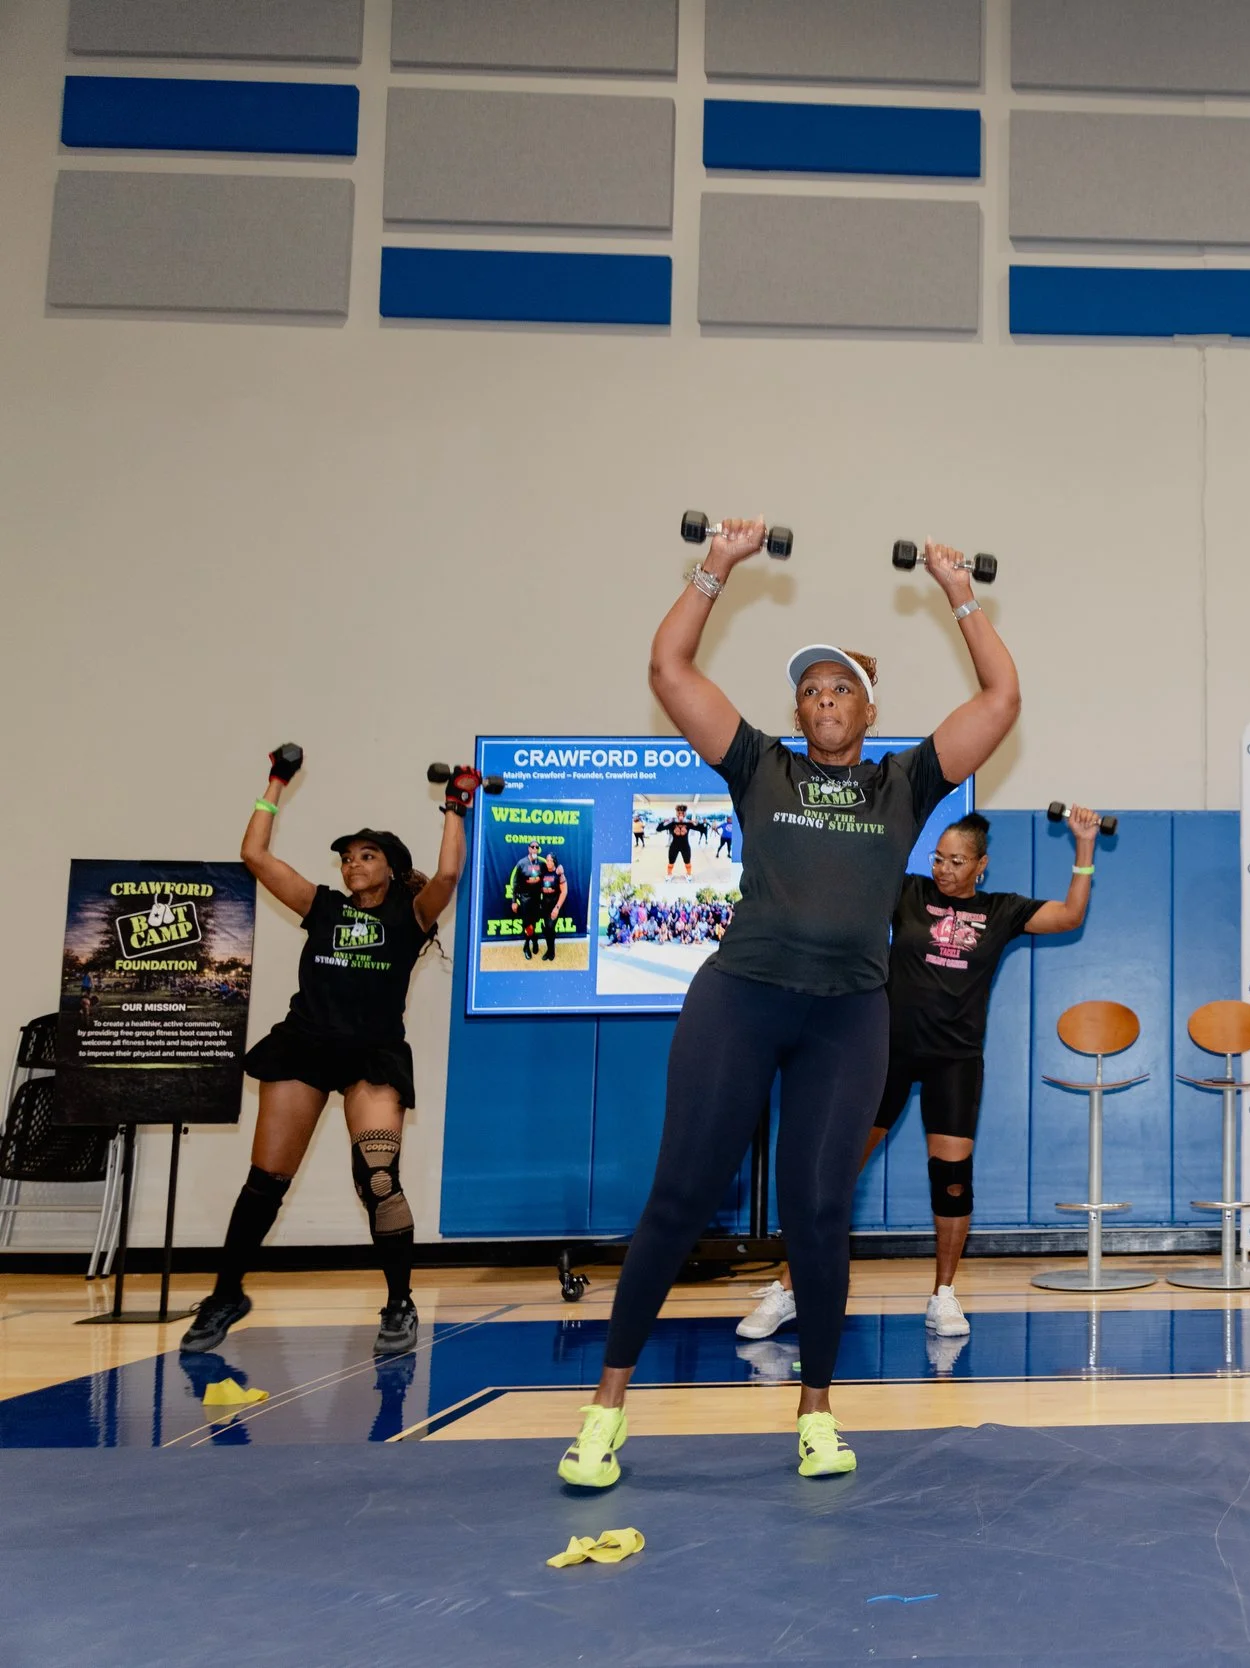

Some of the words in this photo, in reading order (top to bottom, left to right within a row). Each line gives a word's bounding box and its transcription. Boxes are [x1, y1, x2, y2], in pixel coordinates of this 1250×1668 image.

[514, 750, 638, 767] CRAWFORD
[644, 750, 701, 767] BOOT
[503, 771, 531, 780] Marilyn
[532, 771, 565, 780] Crawford
[573, 771, 604, 781] Founder,
[605, 771, 637, 780] Crawford
[639, 771, 656, 780] Boot
[808, 789, 857, 805] CAMP
[491, 806, 580, 825] WELCOME
[804, 809, 830, 821] ONLY
[834, 813, 856, 823] THE
[773, 812, 824, 829] STRONG
[828, 821, 885, 834] SURVIVE
[110, 881, 214, 897] CRAWFORD
[487, 917, 577, 936] FESIAL
[130, 921, 193, 949] CAMP
[339, 934, 378, 947] CAMP
[315, 955, 349, 967] STRONG
[334, 951, 353, 961] ONLY
[356, 954, 372, 962] THE
[115, 960, 197, 971] FOUNDATION
[122, 1003, 142, 1012] OUR
[144, 1003, 186, 1012] MISSION
[184, 1020, 221, 1029] community
[77, 1029, 86, 1037] by
[87, 1029, 119, 1038] providing
[181, 1039, 203, 1048] inspire
[204, 1039, 227, 1048] people
[87, 1050, 114, 1058] improve
[133, 1050, 160, 1058] physical
